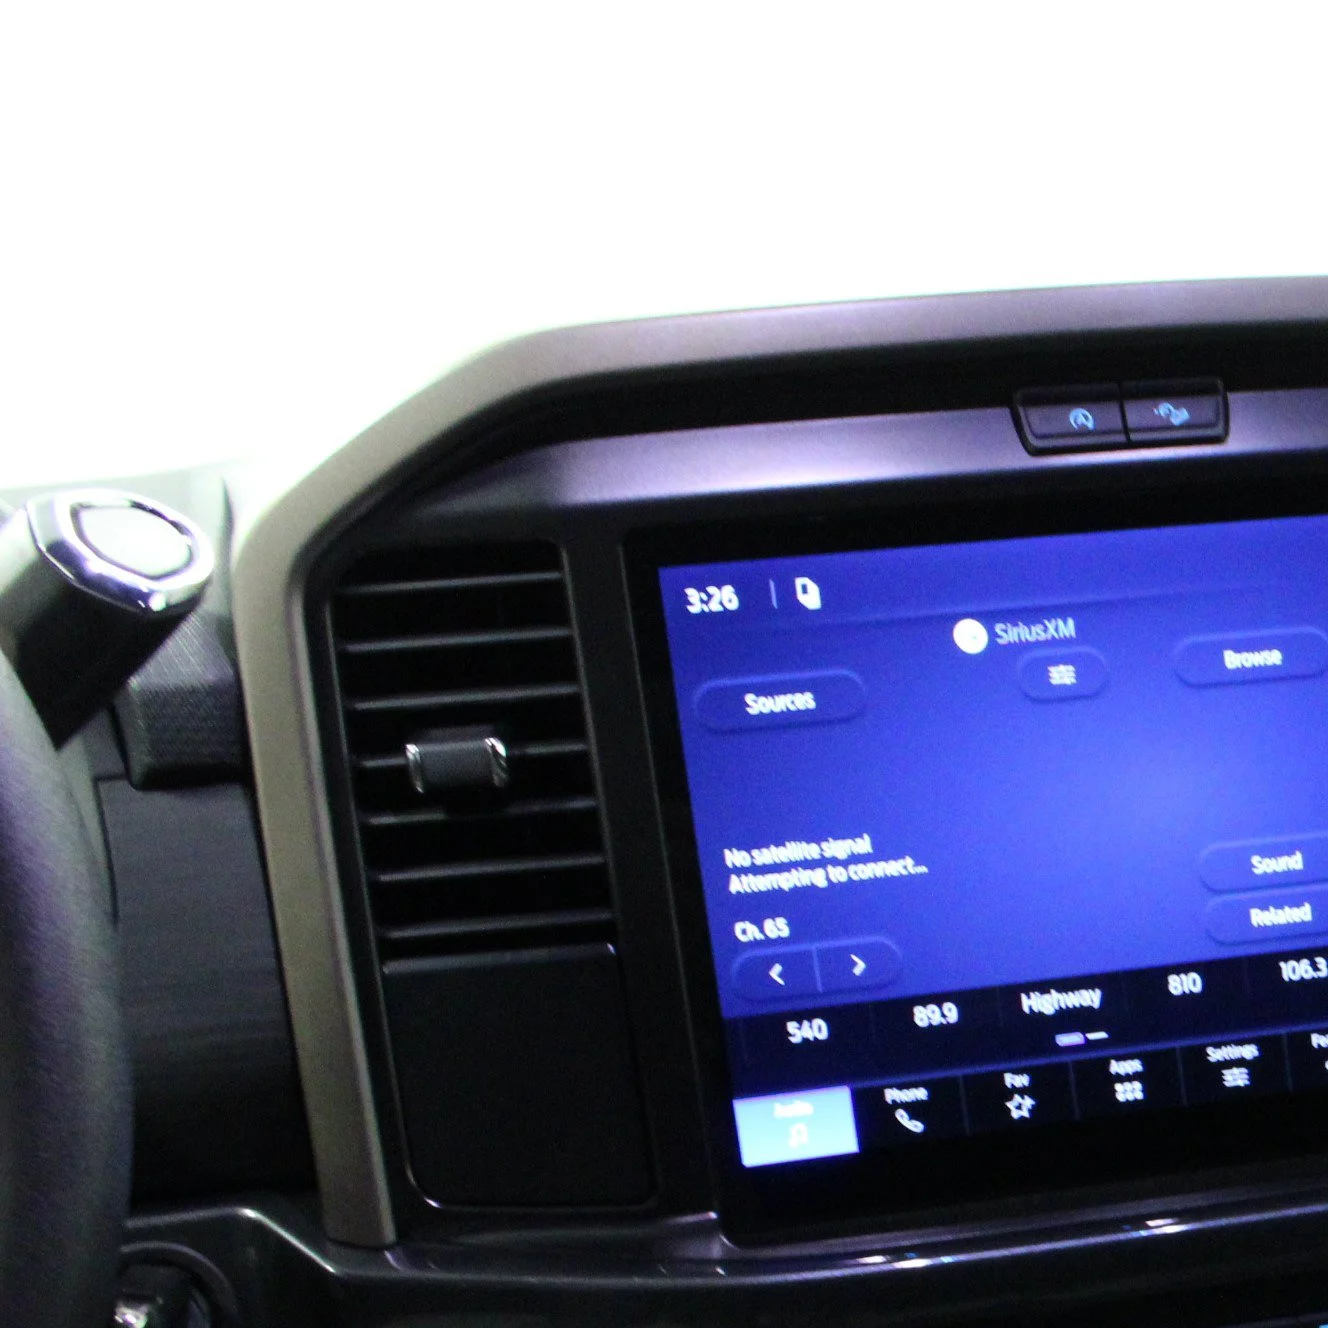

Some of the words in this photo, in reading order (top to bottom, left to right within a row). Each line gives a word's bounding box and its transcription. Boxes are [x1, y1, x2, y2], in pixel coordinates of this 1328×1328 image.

[684, 584, 740, 614] 3:26
[994, 617, 1076, 645] SiriusXM
[1223, 649, 1283, 670] Browse
[744, 692, 817, 716] Sources
[723, 848, 751, 868] No
[750, 840, 822, 866] satellite
[820, 833, 873, 860] signal
[1251, 850, 1304, 875] Sound
[729, 867, 828, 894] Attempting
[827, 864, 848, 883] to
[763, 917, 790, 939] 65
[1250, 902, 1313, 928] Related
[1278, 956, 1328, 983] 106.3
[1167, 971, 1203, 997] 810
[912, 1001, 959, 1028] 89.9
[1020, 987, 1102, 1016] Highway
[785, 1017, 829, 1044] 540
[1205, 1042, 1260, 1064] Settings
[1109, 1058, 1144, 1077] Apps
[883, 1086, 929, 1105] Phone
